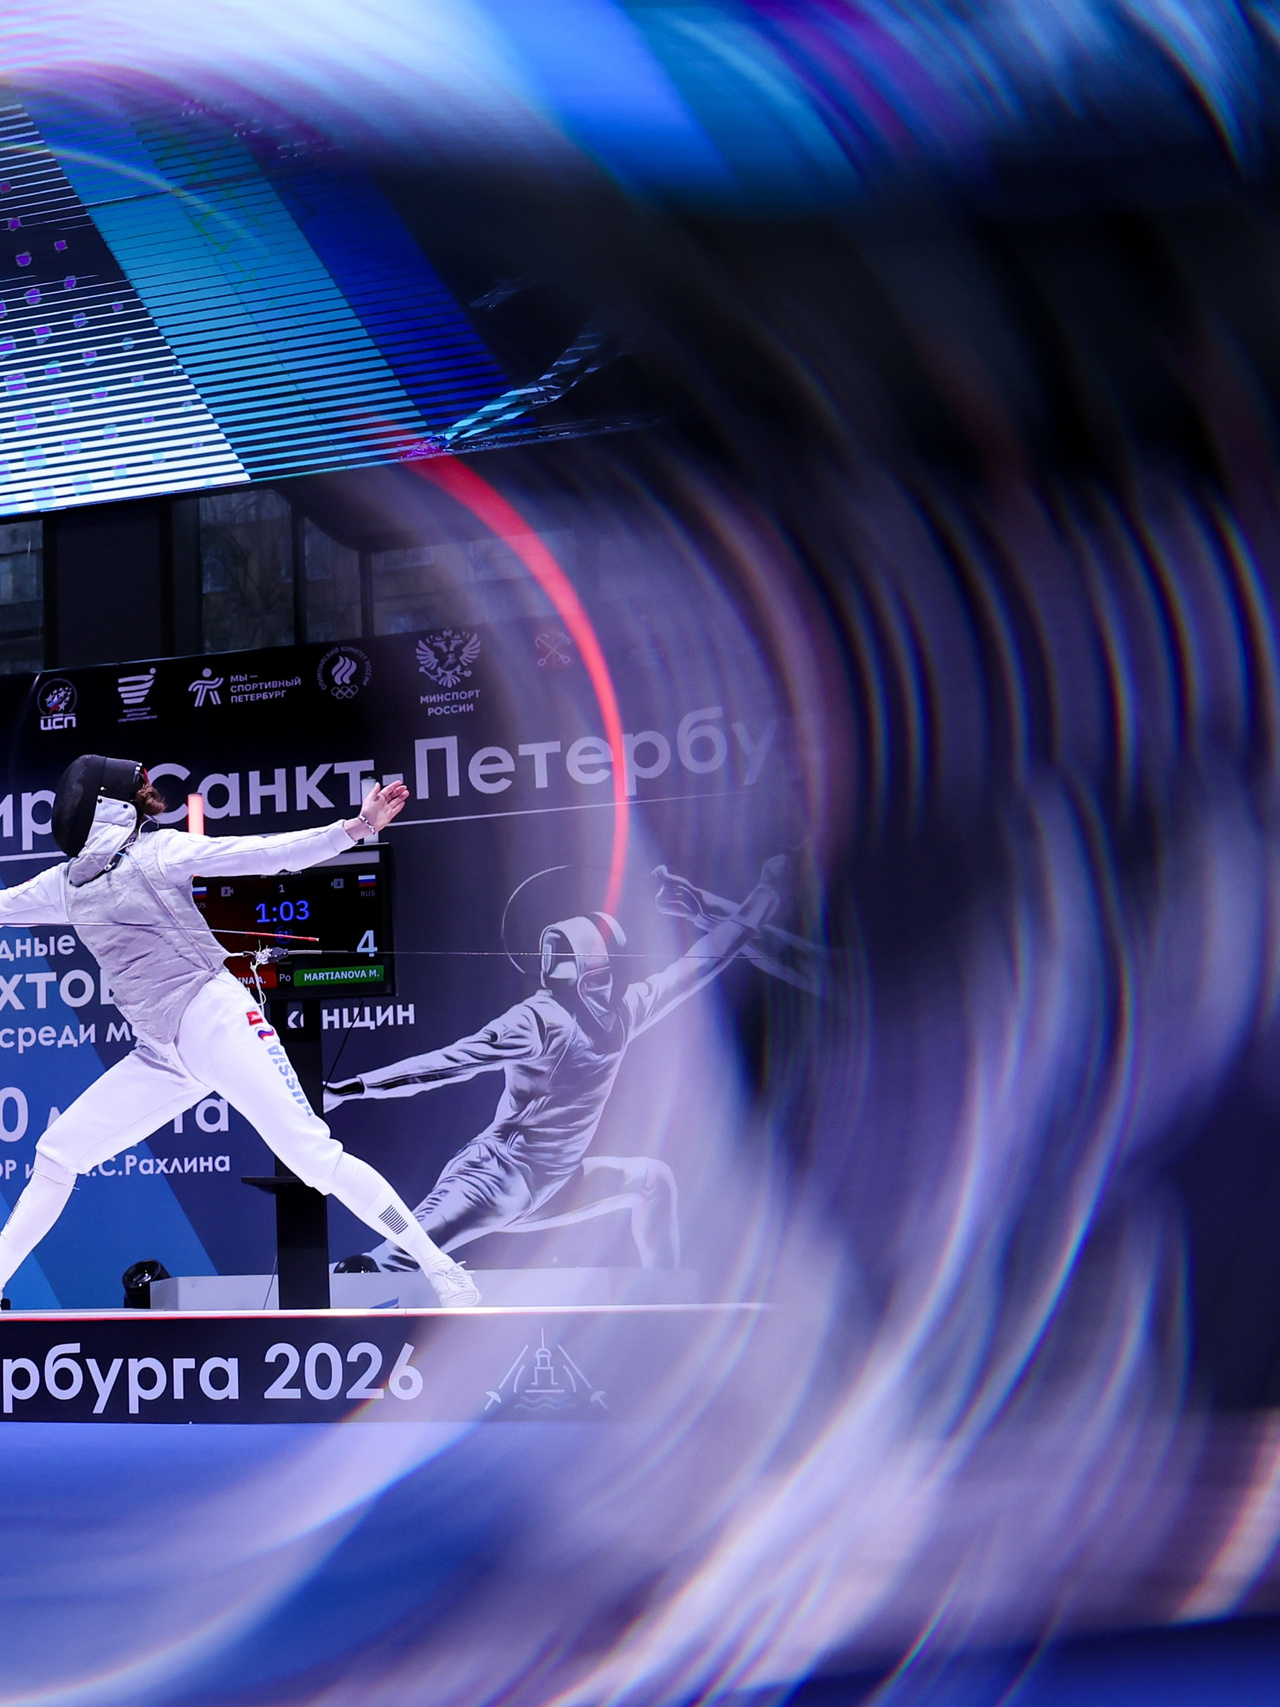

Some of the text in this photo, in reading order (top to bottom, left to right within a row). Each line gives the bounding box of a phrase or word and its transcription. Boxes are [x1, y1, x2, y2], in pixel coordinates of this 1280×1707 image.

[230, 673, 248, 683] МЫ
[230, 676, 302, 693] СПОРТИВНЫЙ
[230, 690, 287, 703] ПЕТЕРБУРГ
[420, 689, 480, 704] МИНСПОРТ
[427, 703, 474, 716] РОССИИ
[40, 716, 76, 731] ЦСП
[278, 884, 285, 893] 1
[255, 900, 310, 923] 1:03
[356, 929, 378, 957] 4
[304, 969, 380, 982] MARTIANOVA M.
[83, 1154, 231, 1179] .С.Рахлина
[263, 1341, 425, 1401] 2026
